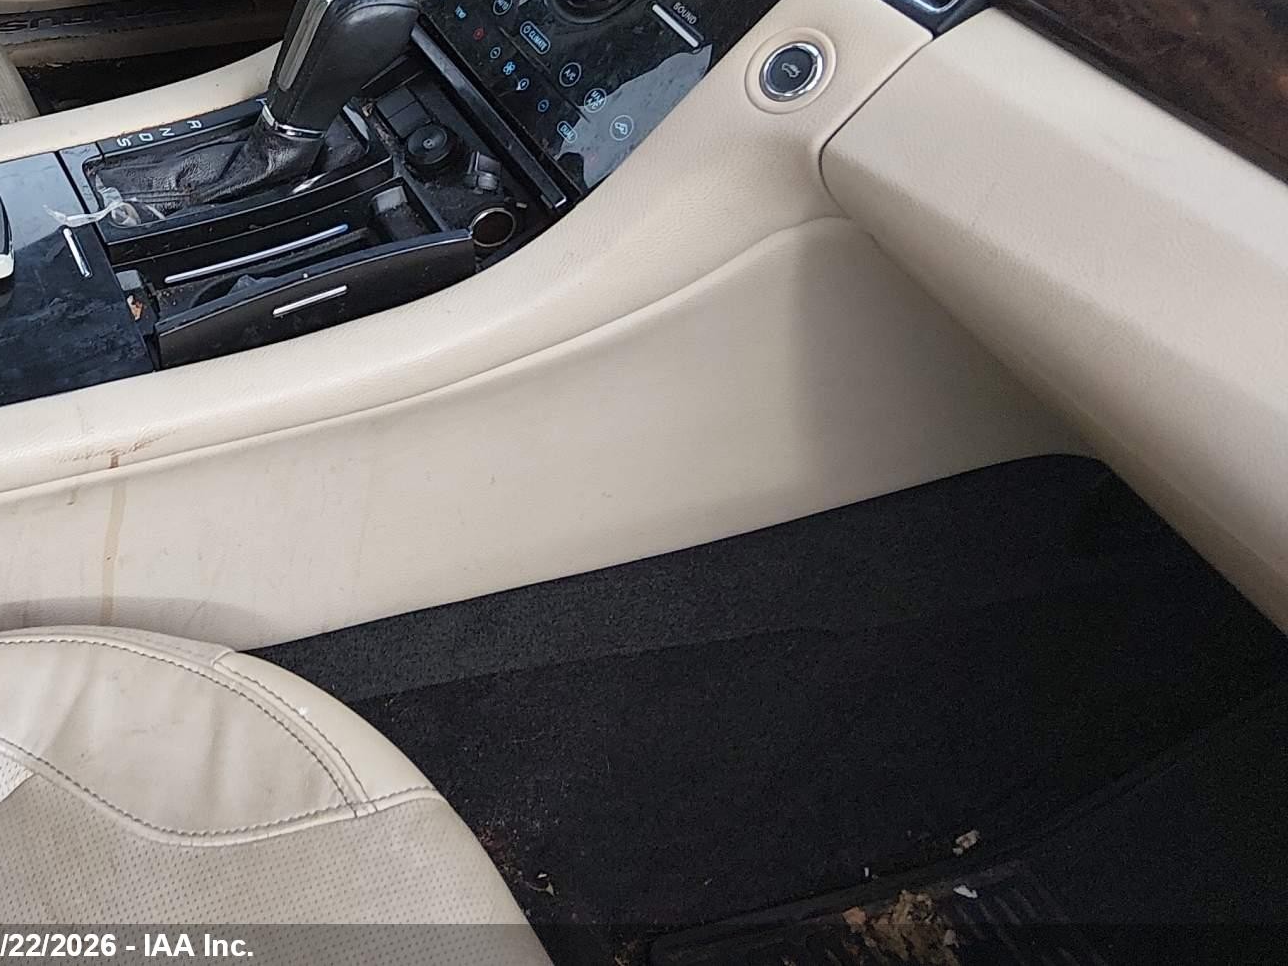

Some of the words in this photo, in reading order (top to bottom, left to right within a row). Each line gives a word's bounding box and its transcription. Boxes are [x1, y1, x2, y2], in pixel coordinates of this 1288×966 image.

[673, 2, 697, 24] SOUND
[529, 30, 547, 50] CLIMATE
[564, 69, 576, 81] A/C
[187, 120, 202, 129] R
[138, 132, 154, 142] D
[159, 127, 175, 137] N
[117, 136, 132, 147] S
